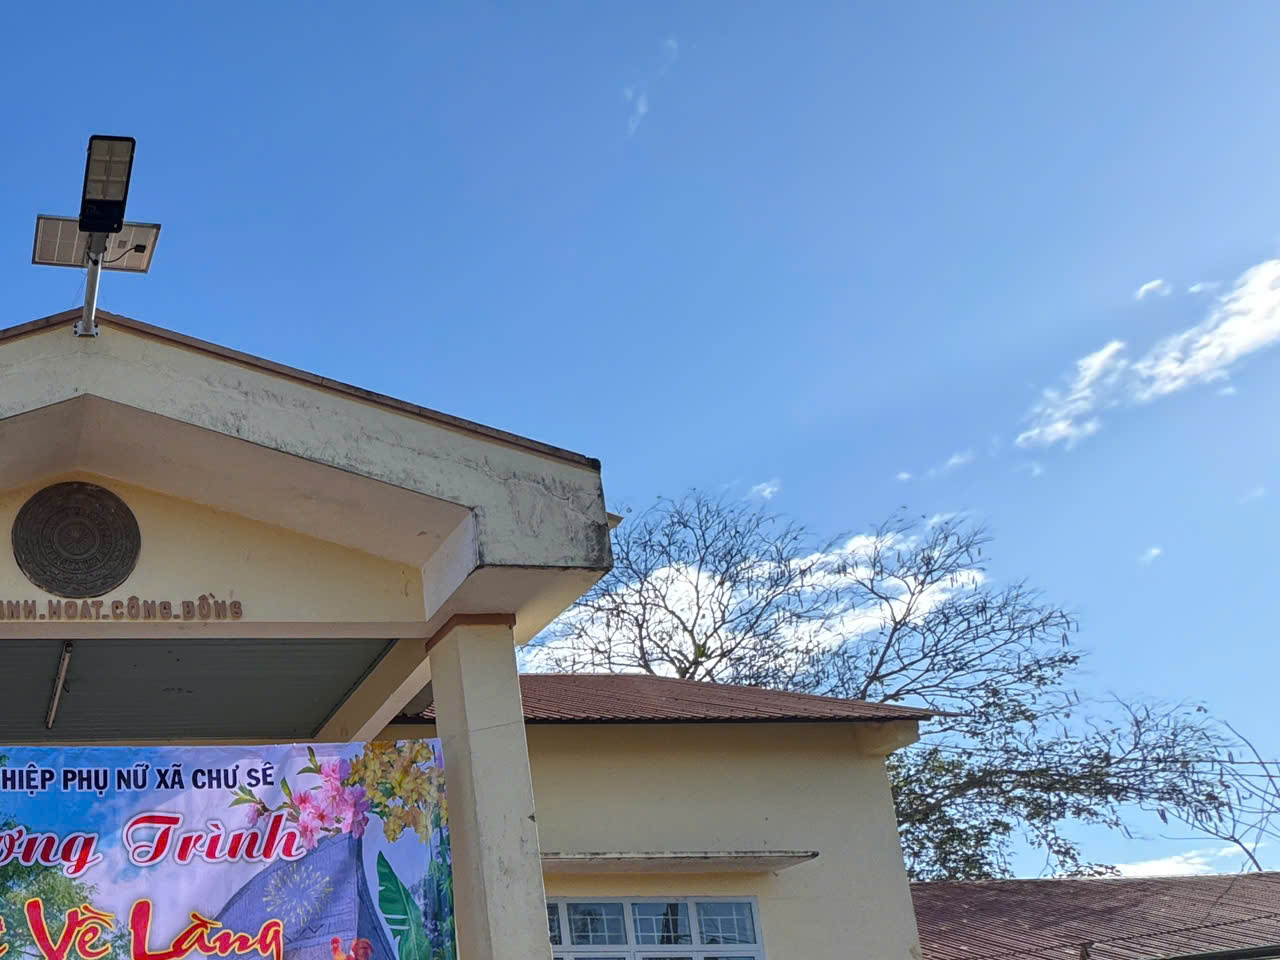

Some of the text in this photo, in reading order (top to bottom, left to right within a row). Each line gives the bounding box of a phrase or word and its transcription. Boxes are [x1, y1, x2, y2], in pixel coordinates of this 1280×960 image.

[1, 764, 53, 796] HIỆP
[63, 768, 108, 796] PHỤ
[117, 763, 149, 790] NỮ
[156, 764, 185, 790] XÃ
[192, 764, 241, 790] CHƯ
[246, 761, 275, 788] SÊ
[125, 812, 305, 865] Trình
